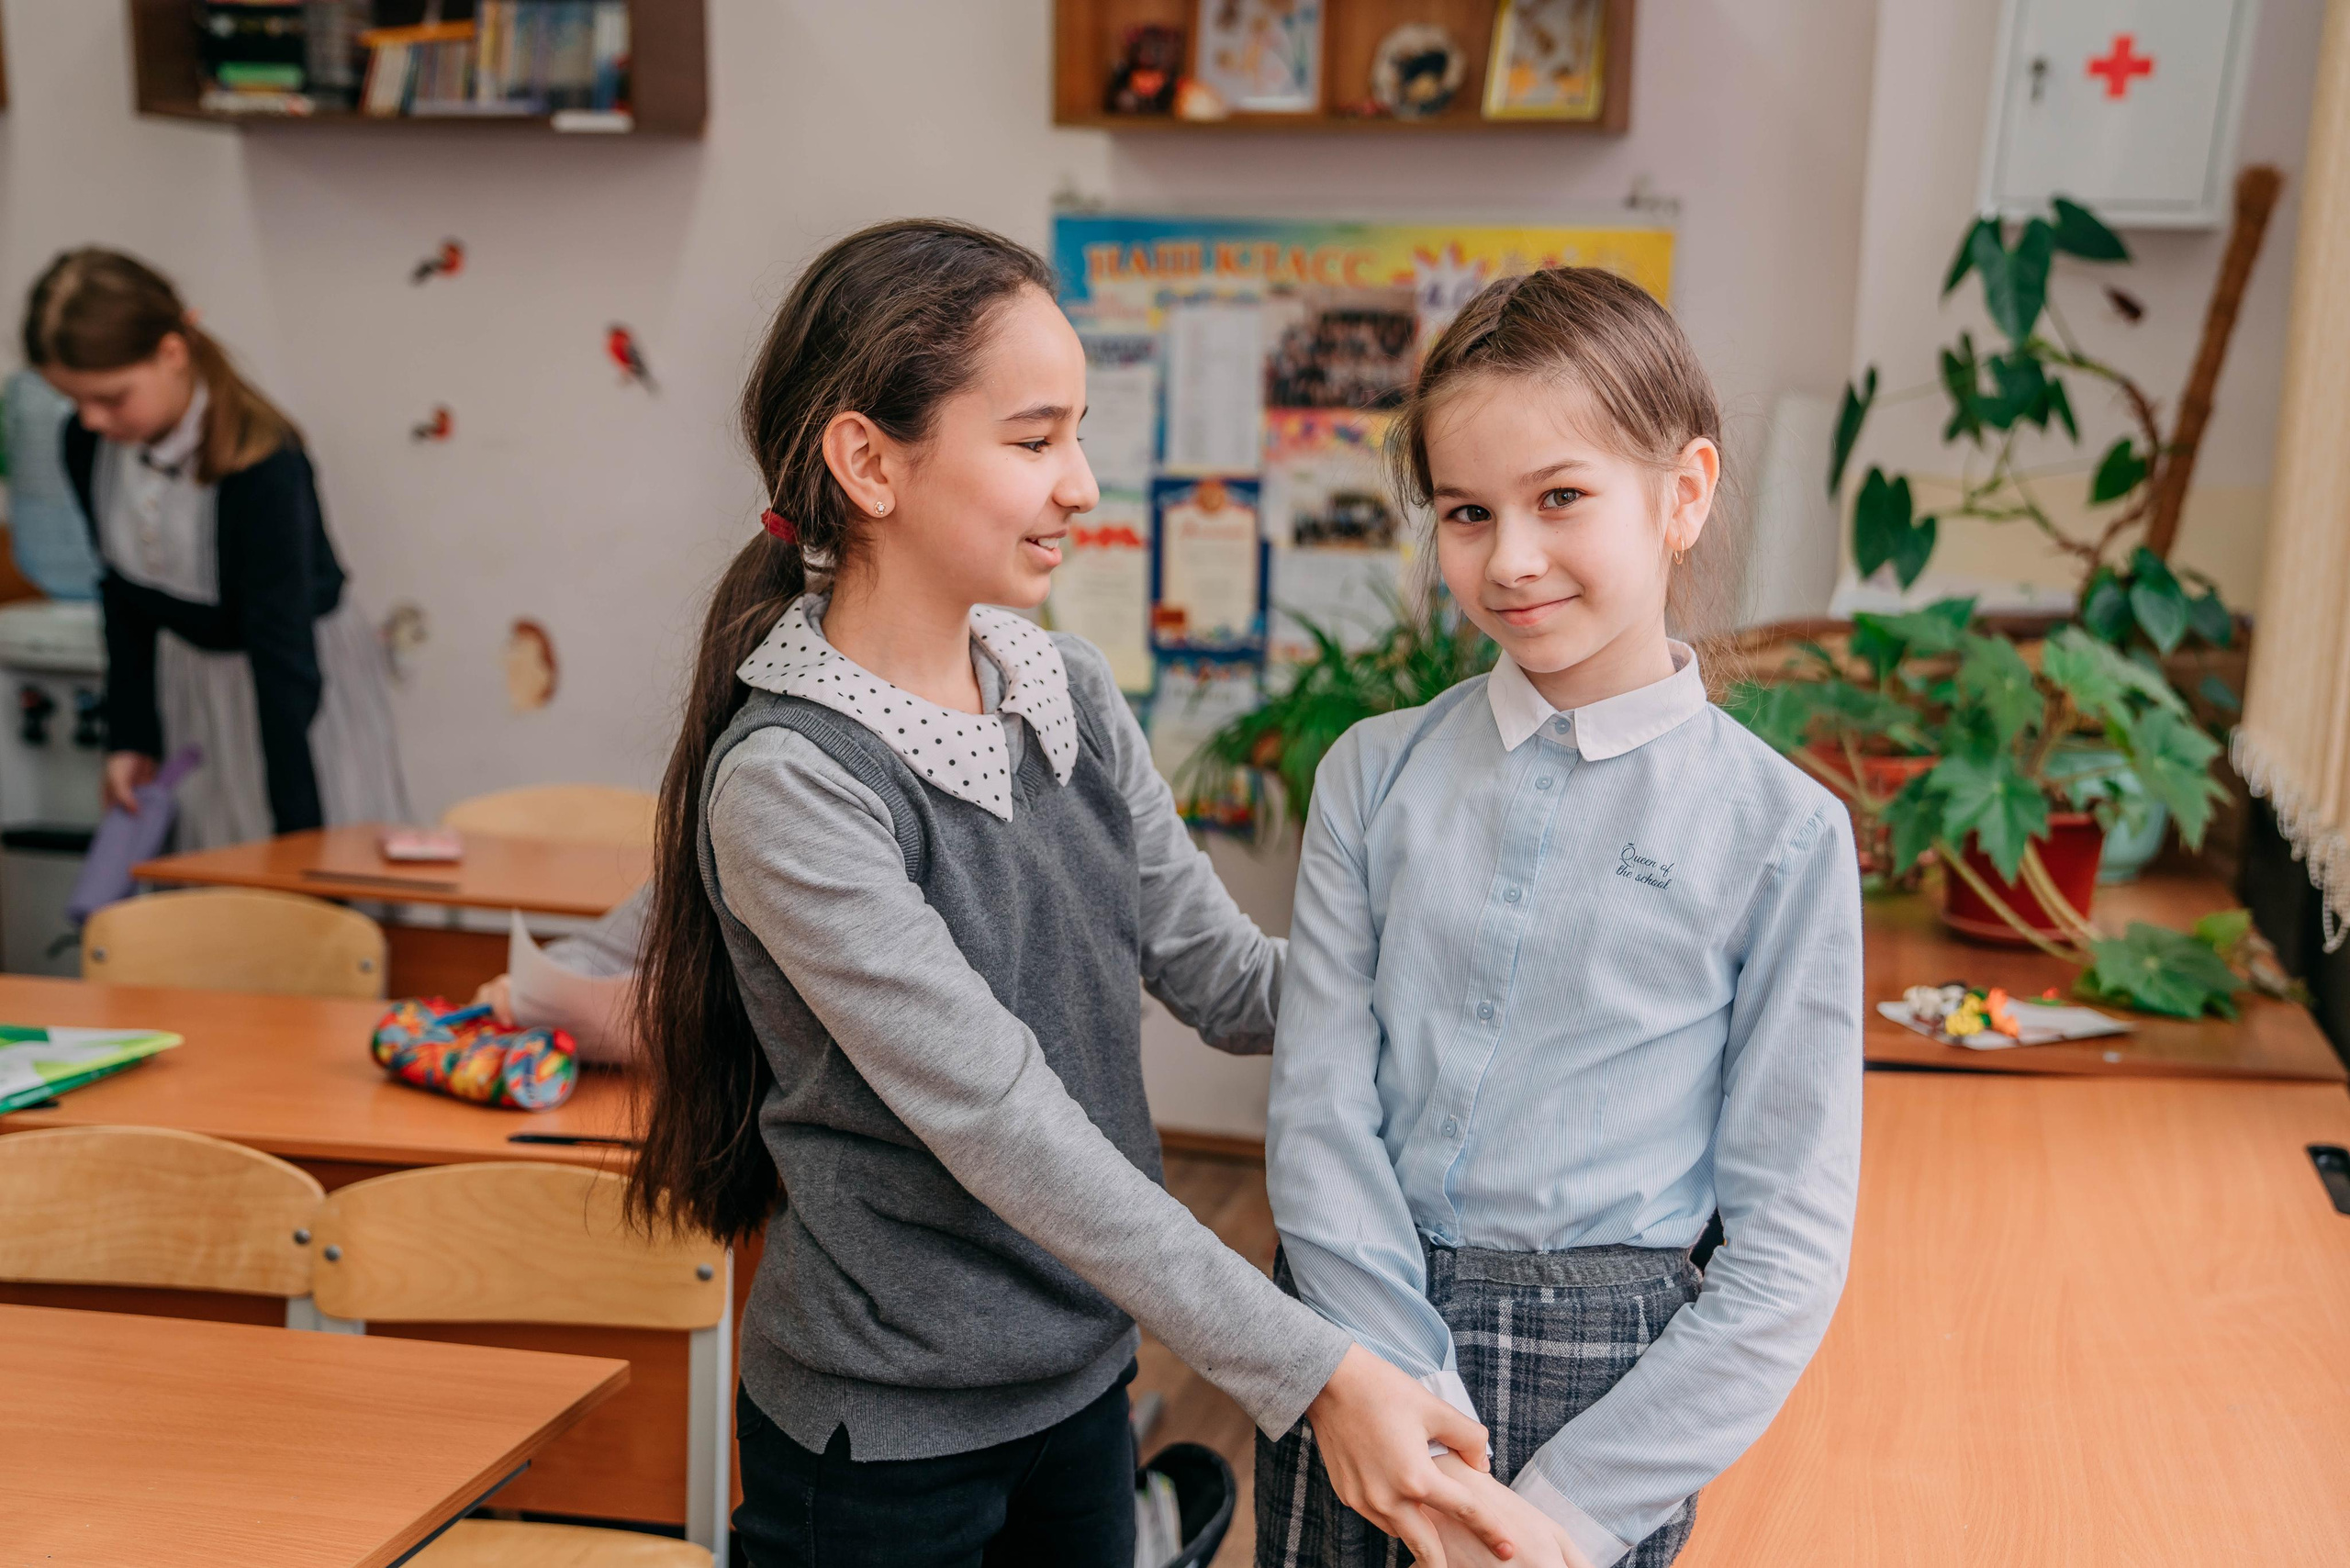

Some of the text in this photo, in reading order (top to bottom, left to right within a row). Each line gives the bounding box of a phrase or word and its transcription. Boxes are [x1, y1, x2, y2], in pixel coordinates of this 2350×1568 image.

[1214, 241, 1380, 291] КЛАСС
[1616, 864, 1672, 890] the school
[1619, 842, 1674, 877] Queen of
